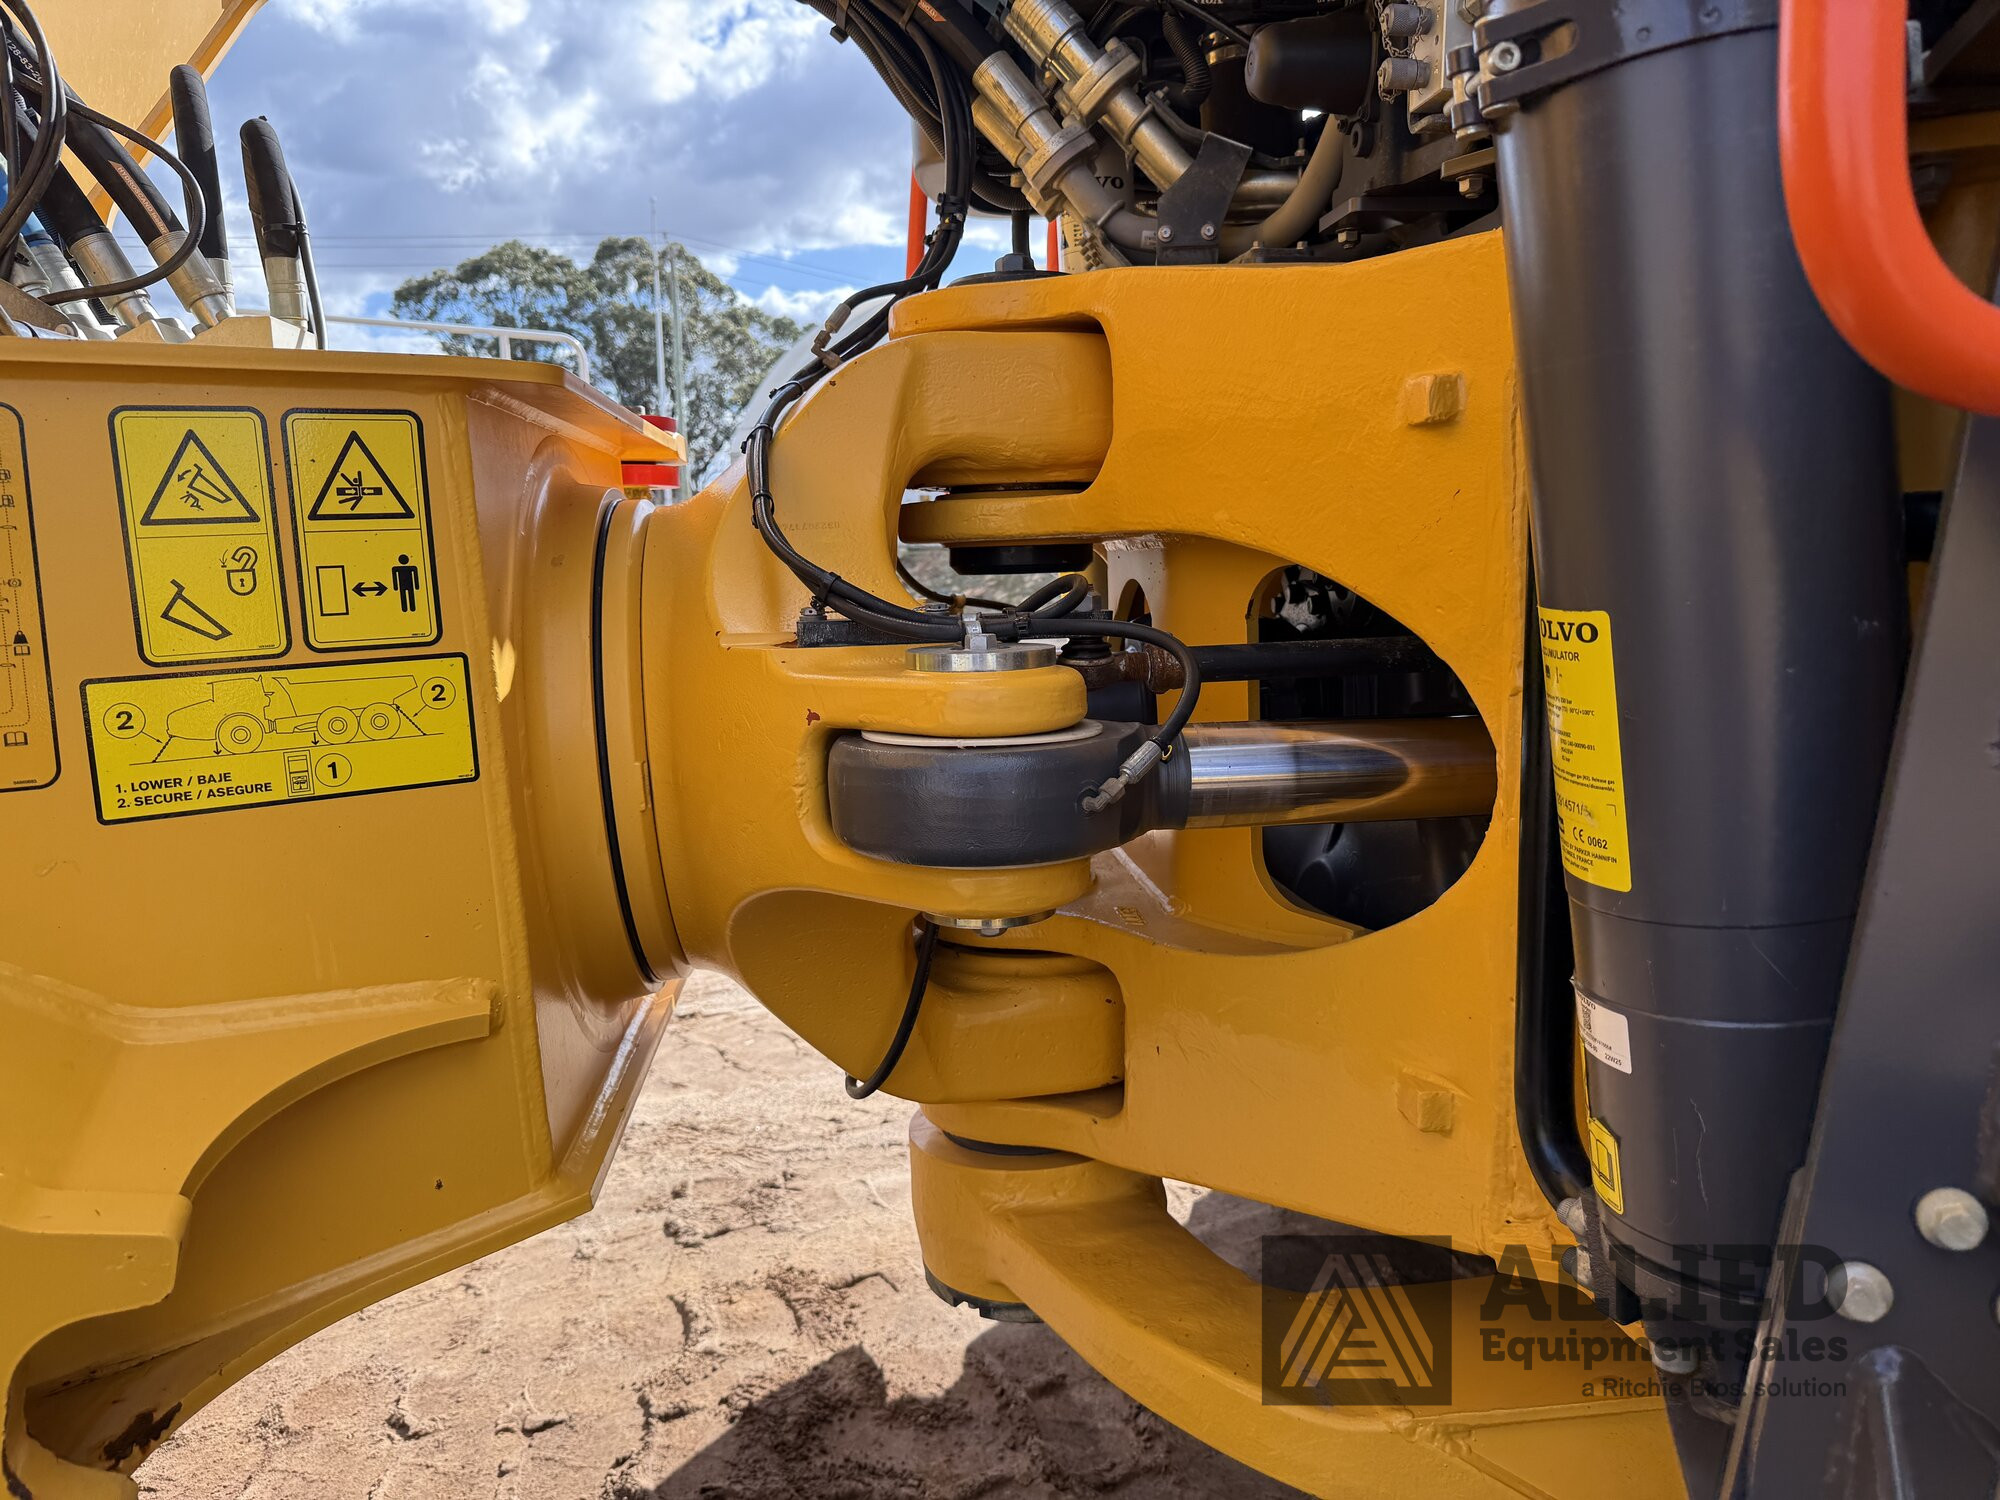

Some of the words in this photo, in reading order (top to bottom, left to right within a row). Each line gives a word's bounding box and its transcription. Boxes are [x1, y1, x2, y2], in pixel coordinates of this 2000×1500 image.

[1095, 175, 1124, 190] VO
[1540, 618, 1599, 643] OLVO
[430, 683, 447, 702] 2
[115, 710, 135, 731] 2
[327, 761, 338, 779] 1
[115, 783, 127, 794] 1.
[131, 777, 182, 793] LOWER
[187, 776, 193, 787] /
[197, 772, 232, 785] BAJE
[117, 797, 131, 809] 2.
[134, 791, 193, 807] SECURE
[196, 789, 203, 800] /
[206, 782, 273, 799] ASEGURE
[1587, 836, 1608, 850] 0062
